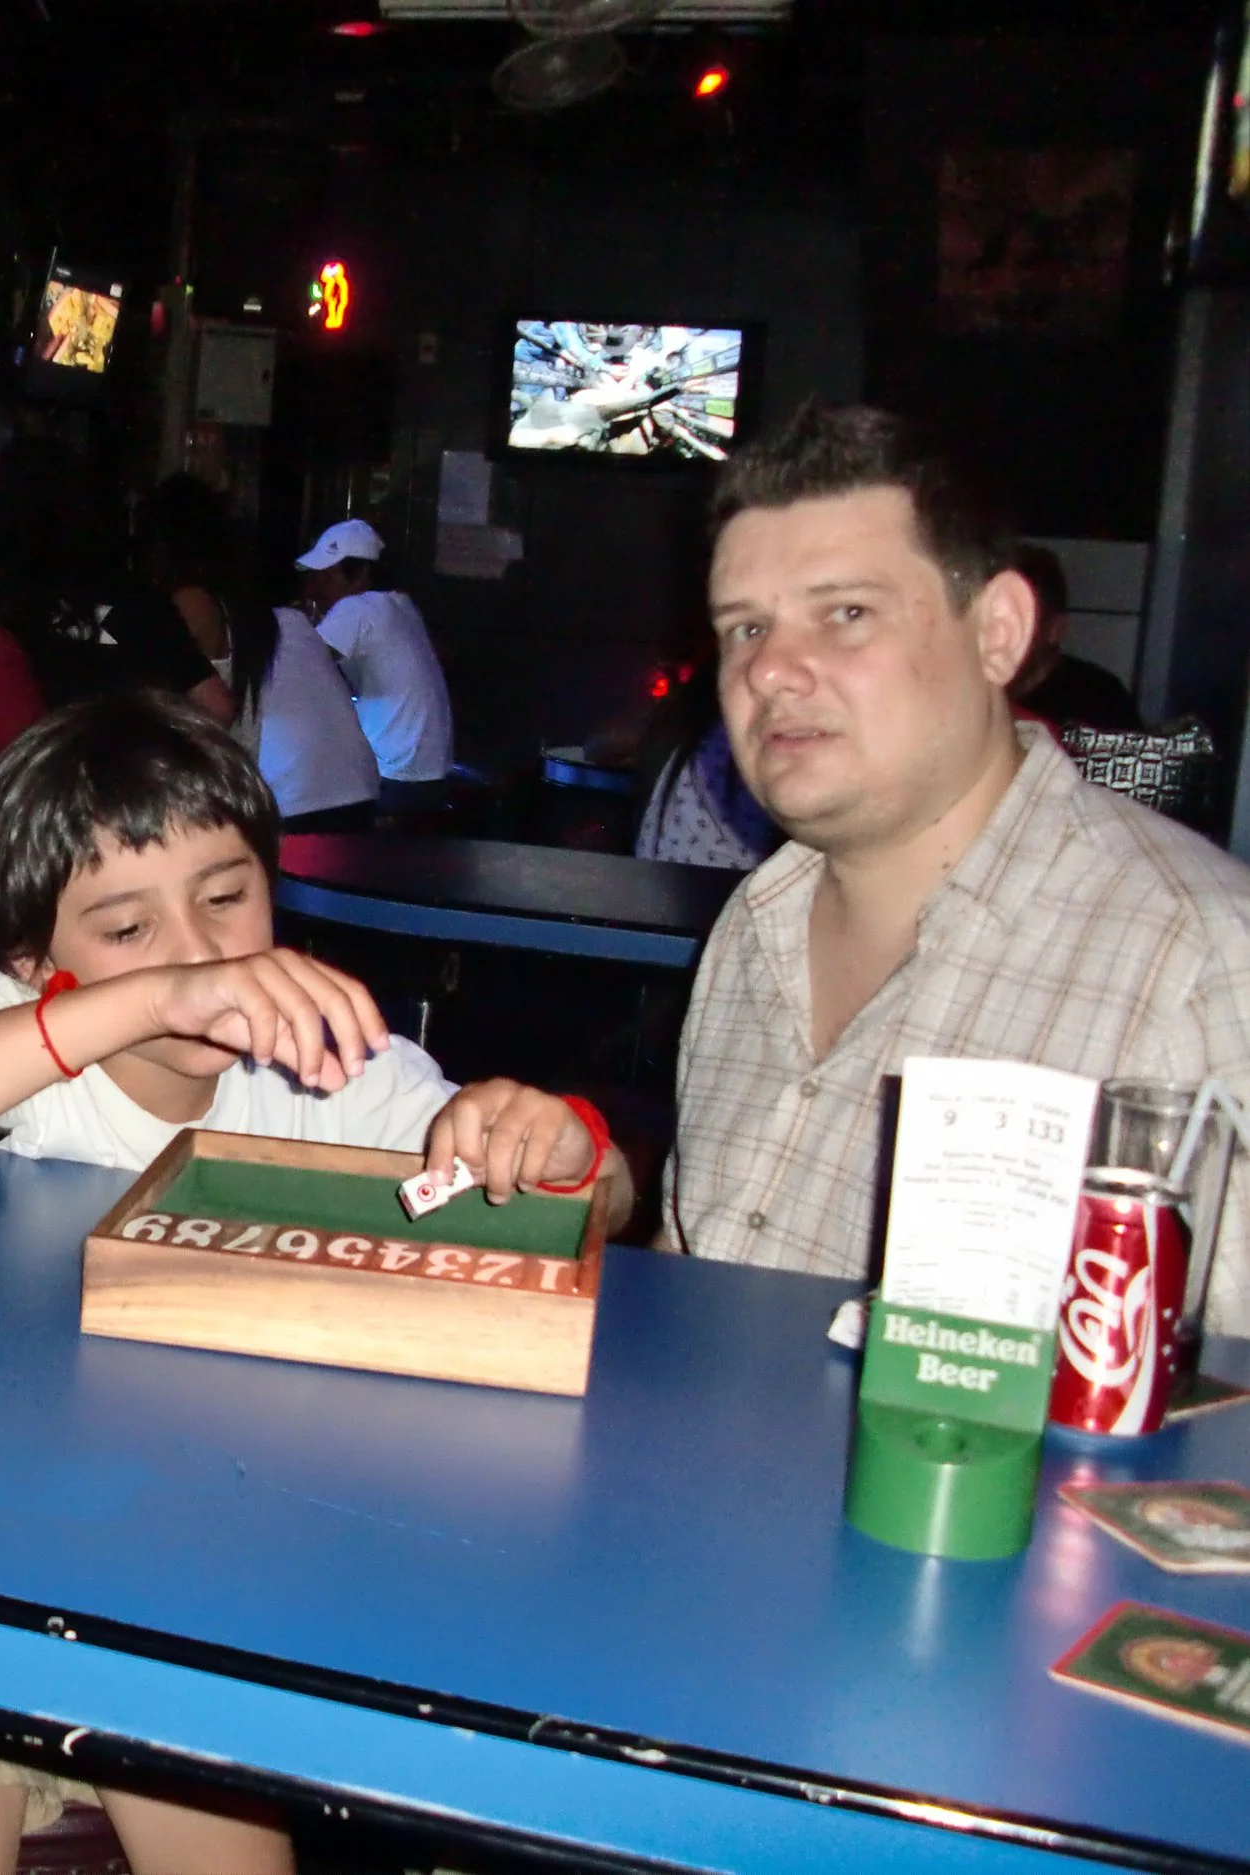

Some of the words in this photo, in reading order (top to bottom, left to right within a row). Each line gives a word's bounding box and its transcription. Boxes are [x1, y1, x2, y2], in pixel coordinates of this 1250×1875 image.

[943, 1108, 958, 1127] 9
[994, 1111, 1009, 1131] 3
[1028, 1117, 1065, 1145] 133
[883, 1313, 1040, 1367] Heineken
[916, 1352, 998, 1393] Beer
